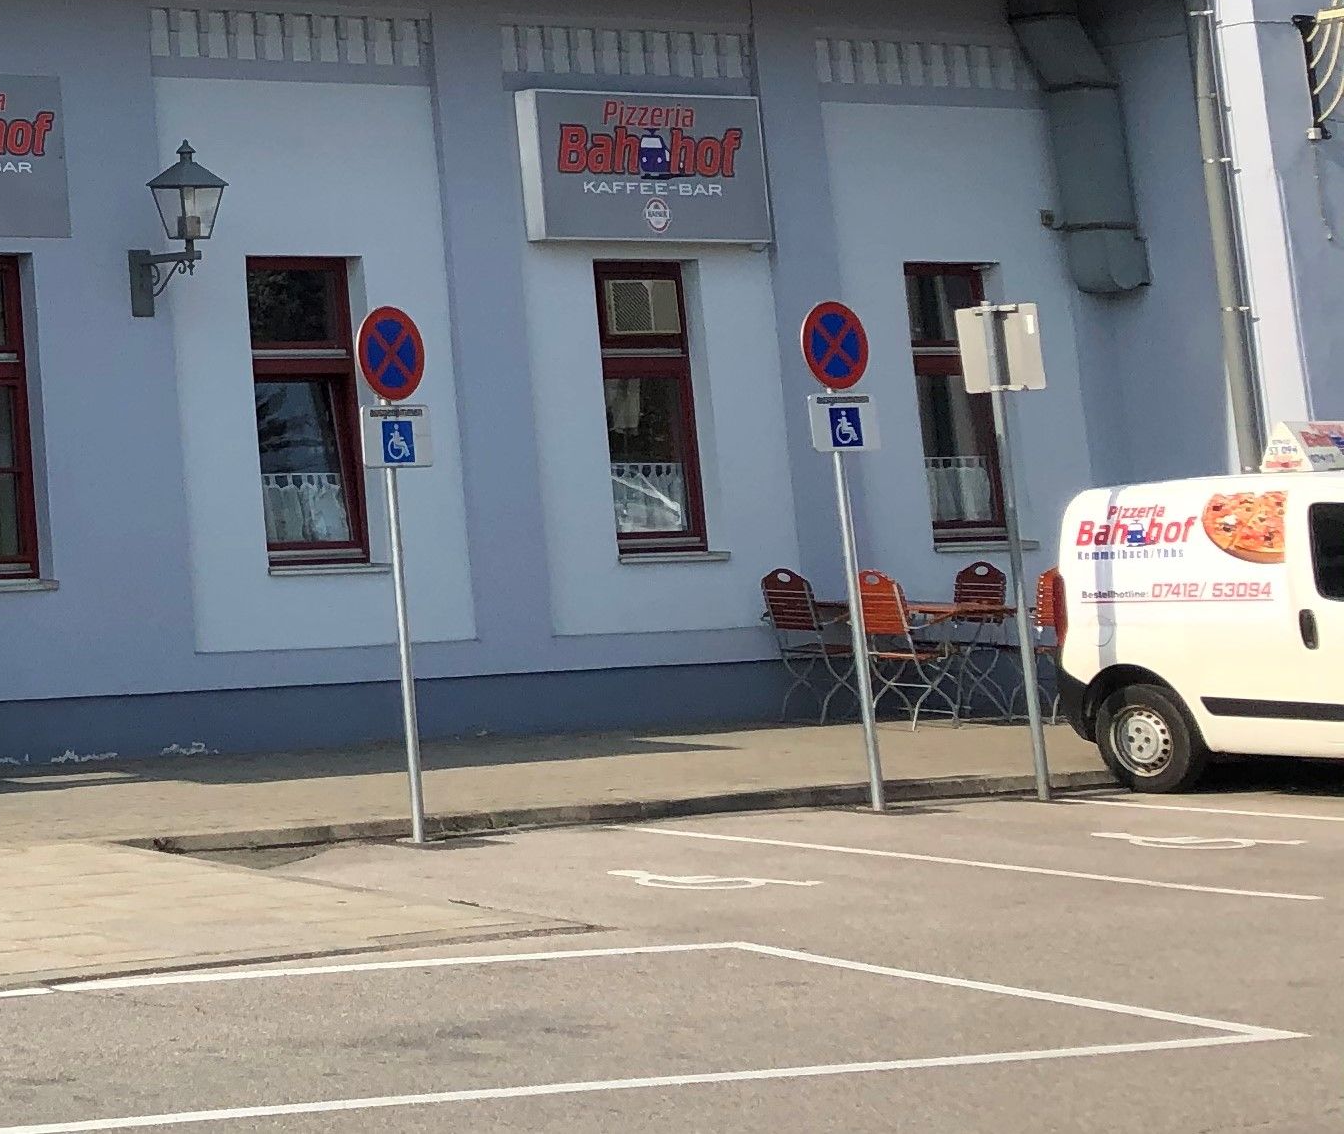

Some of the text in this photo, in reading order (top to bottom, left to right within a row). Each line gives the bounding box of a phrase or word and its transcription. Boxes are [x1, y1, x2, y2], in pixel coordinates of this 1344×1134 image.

[603, 100, 695, 128] Pizzeria
[583, 181, 723, 197] KAFFEE-BAR
[1107, 503, 1165, 521] Pizzeria
[1077, 548, 1184, 560] Kemmelbach/Ybbs
[1081, 590, 1149, 599] Bestellhotline:
[1212, 581, 1273, 598] 53094
